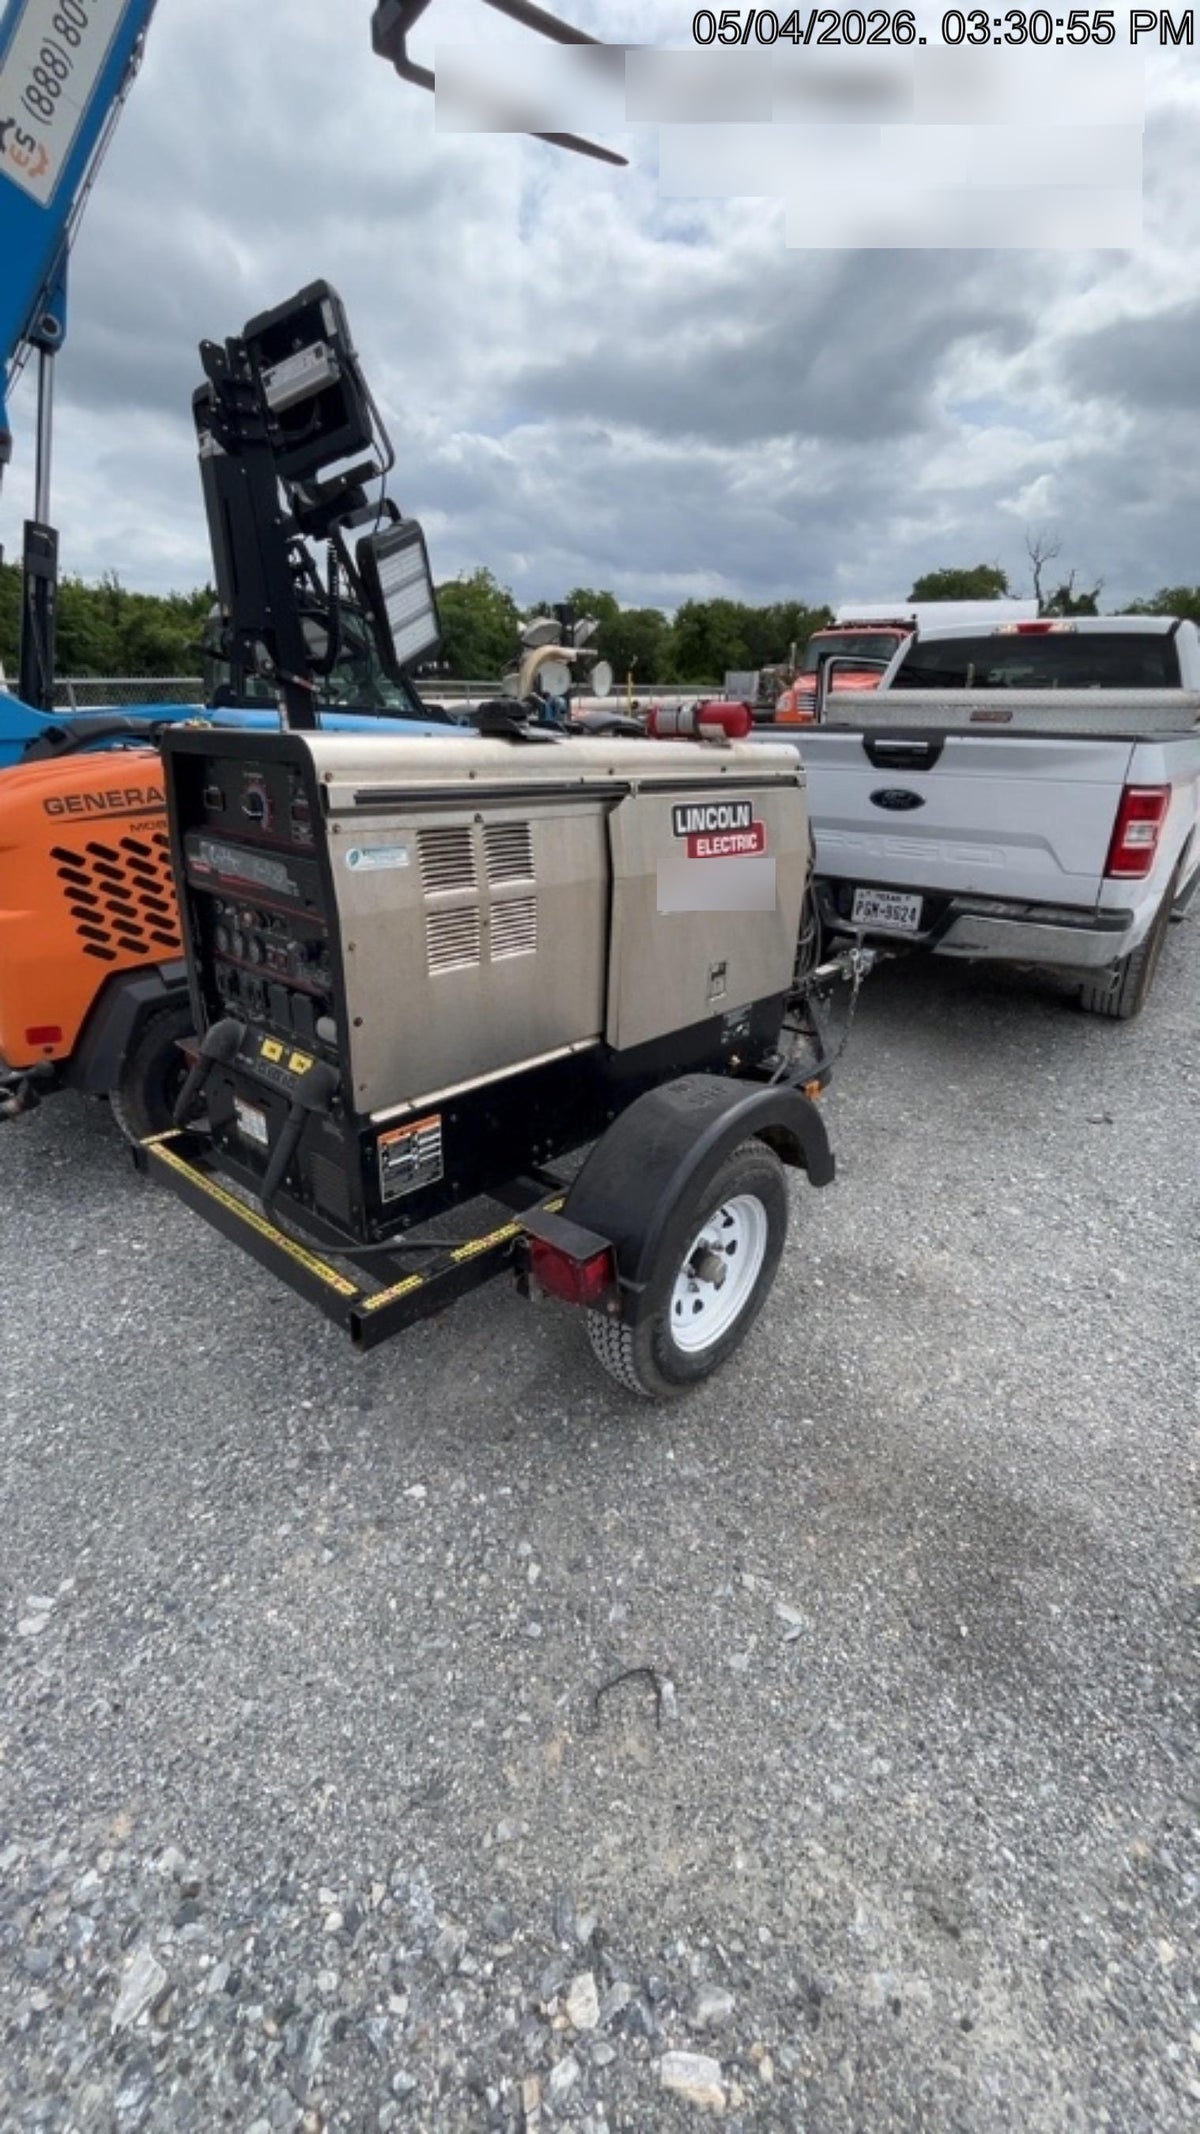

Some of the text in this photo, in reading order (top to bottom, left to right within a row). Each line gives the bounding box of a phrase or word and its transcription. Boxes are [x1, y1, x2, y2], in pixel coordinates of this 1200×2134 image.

[21, 0, 98, 126] (888) 80
[675, 804, 750, 833] LINCOLN
[696, 832, 758, 857] ELECTRIC
